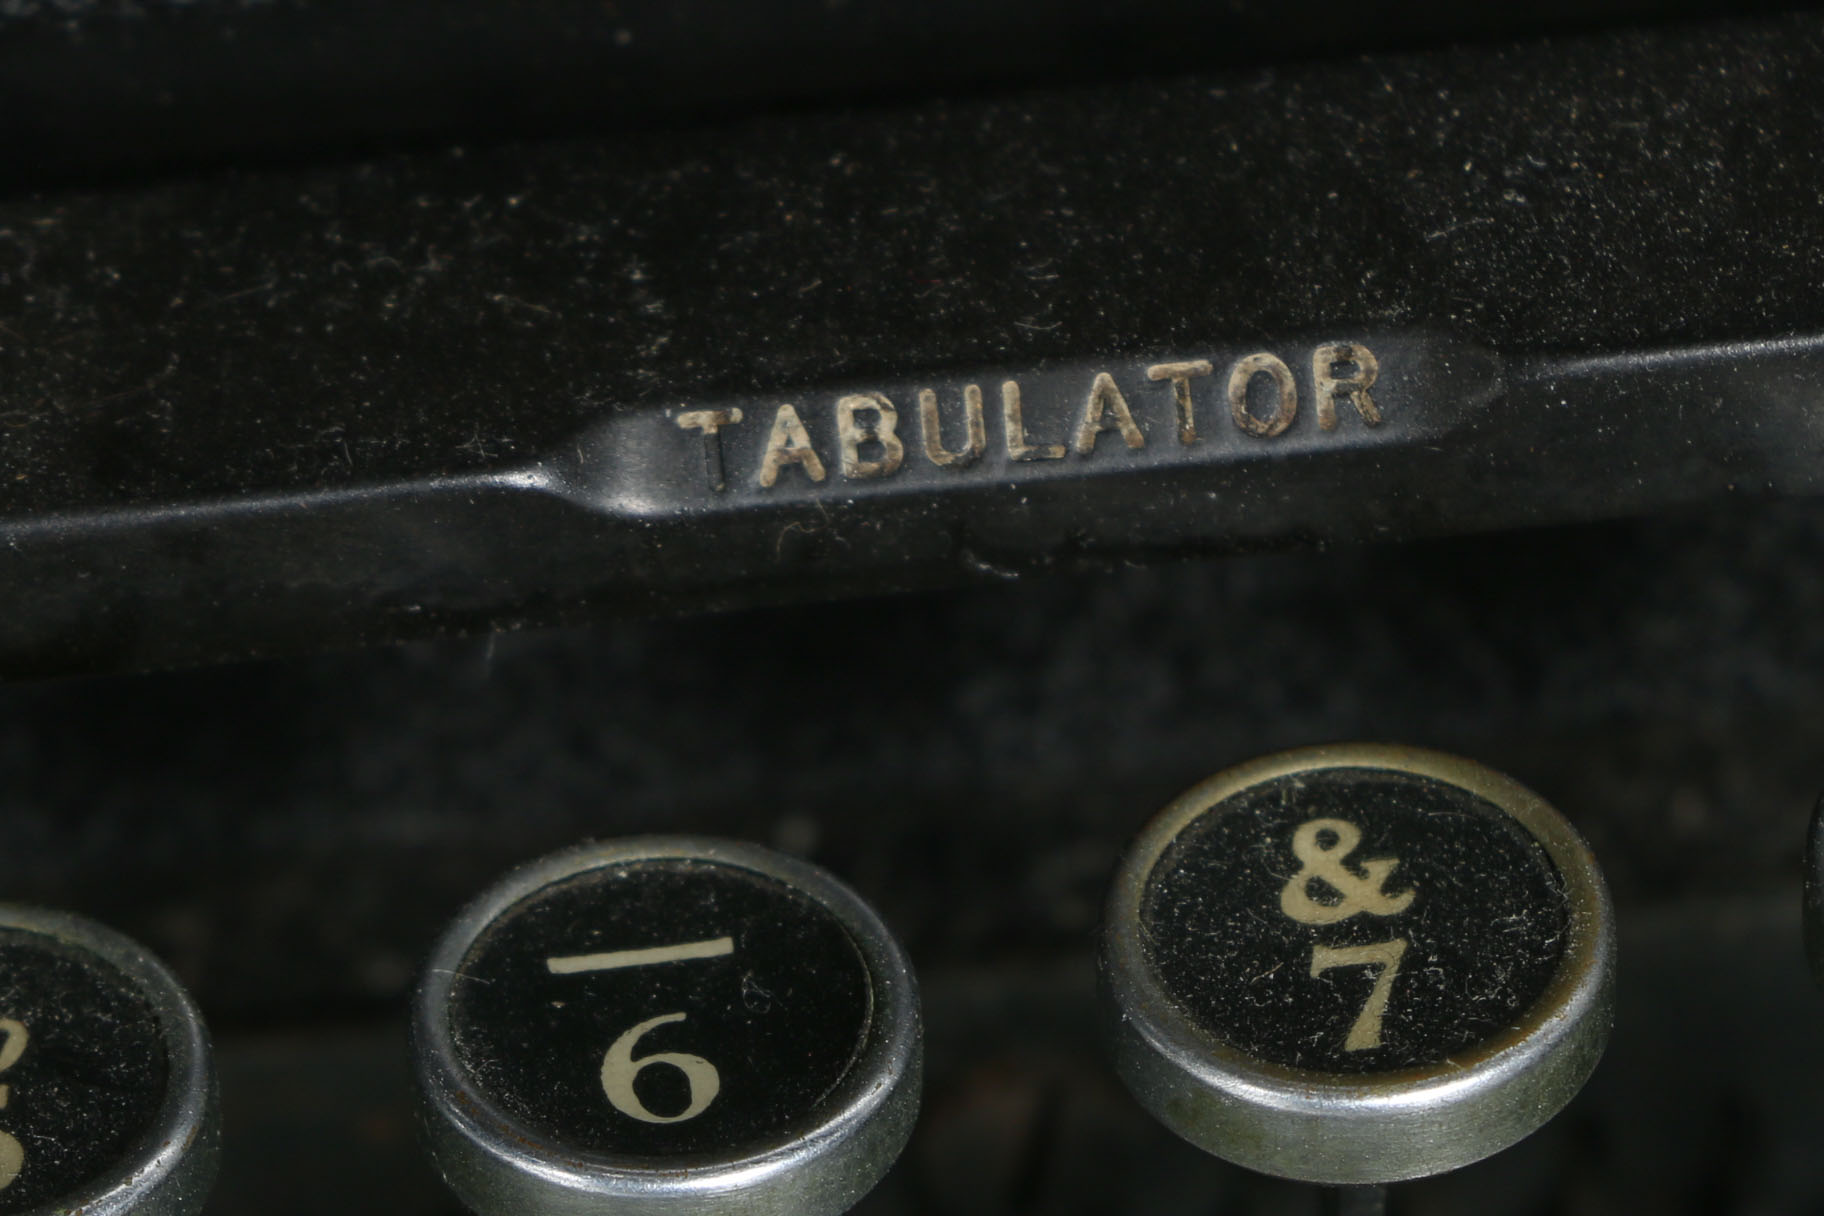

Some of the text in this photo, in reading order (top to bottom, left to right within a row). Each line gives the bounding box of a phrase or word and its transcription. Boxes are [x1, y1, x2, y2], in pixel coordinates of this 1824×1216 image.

[676, 340, 1384, 492] TABULATOR
[1280, 817, 1415, 926] &
[1309, 937, 1408, 1052] 7
[600, 1012, 721, 1124] 6
